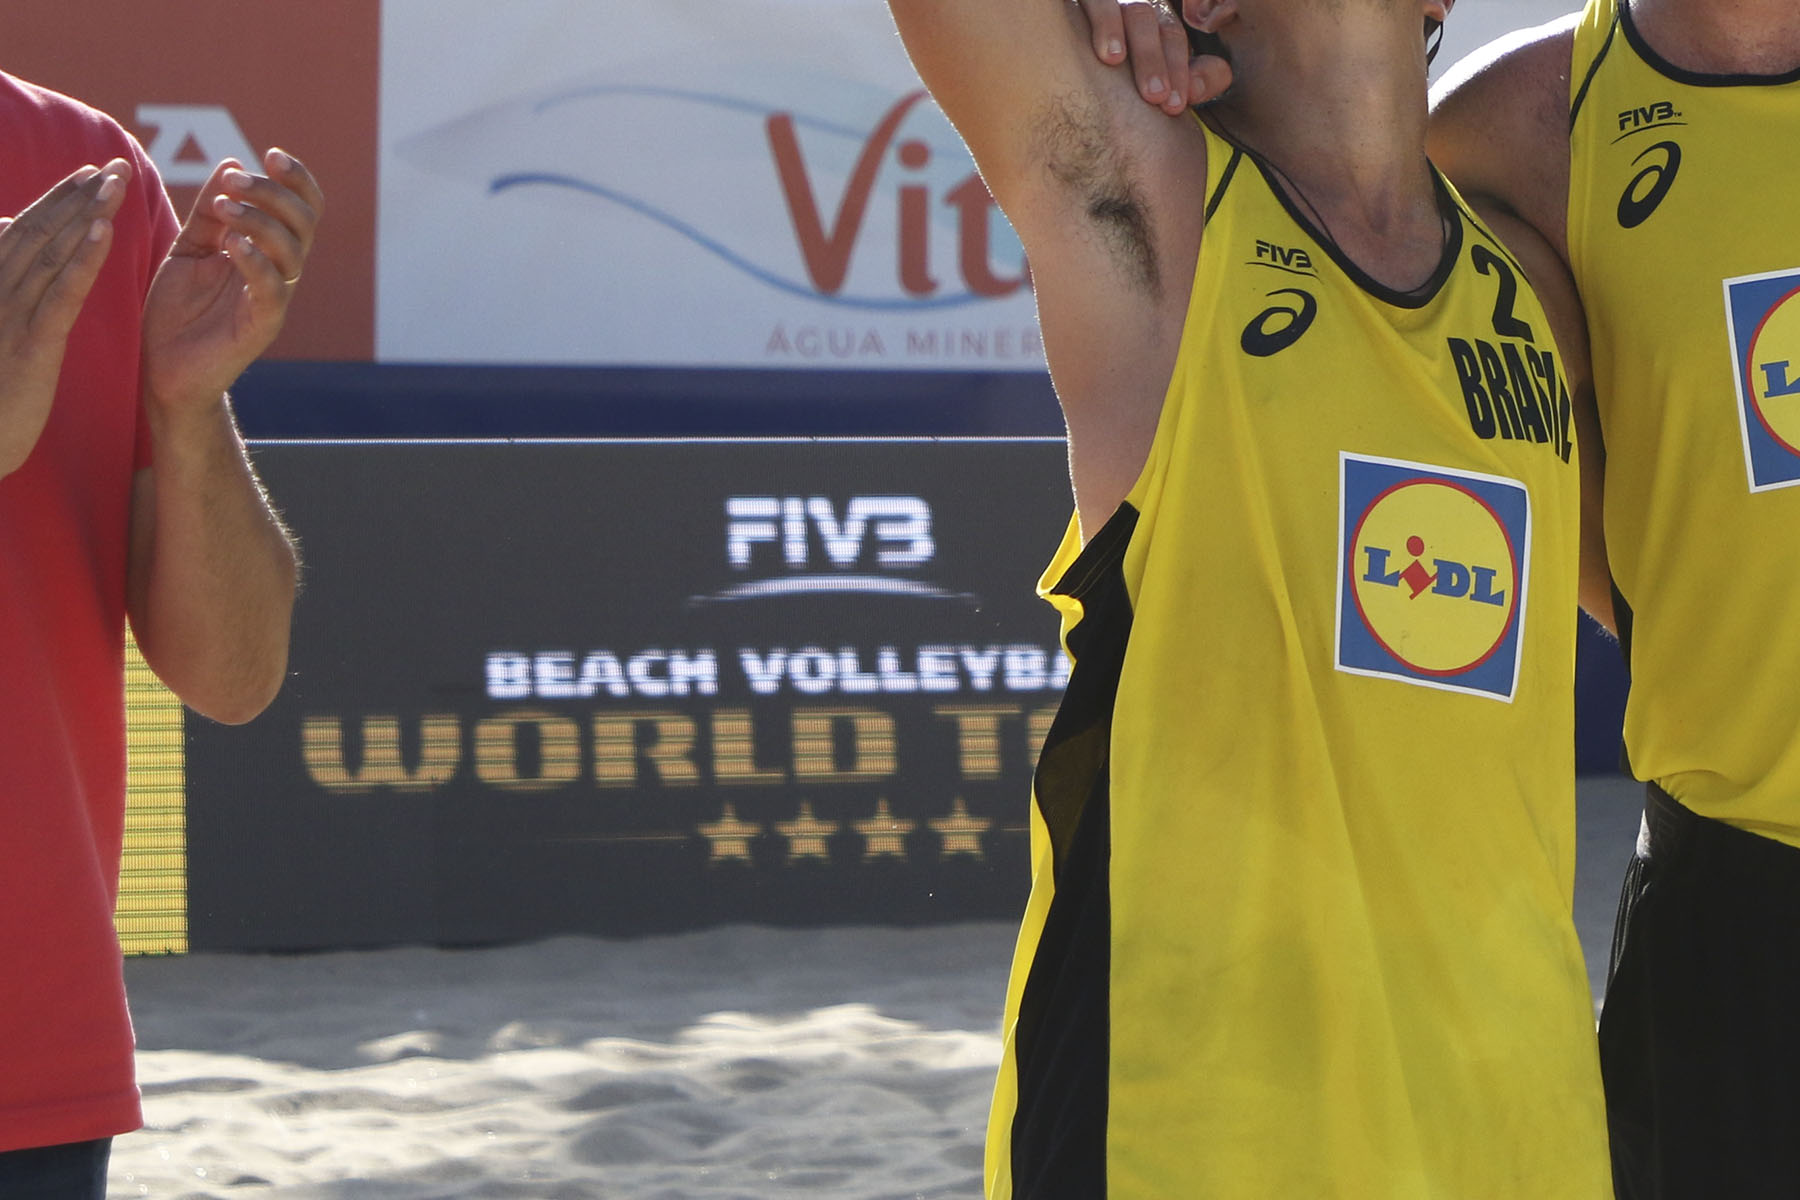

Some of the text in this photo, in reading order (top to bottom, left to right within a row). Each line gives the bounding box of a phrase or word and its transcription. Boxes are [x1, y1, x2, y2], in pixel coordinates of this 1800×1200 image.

[1617, 101, 1676, 131] FIVB
[765, 87, 1034, 298] Vit
[1256, 239, 1313, 269] FIVB
[1471, 243, 1535, 344] 2
[765, 318, 887, 359] ÁGUA
[1447, 337, 1573, 464] BRASIL
[725, 494, 936, 568] FIVB
[486, 647, 718, 699] BEACH
[300, 703, 1061, 792] WORLD T
